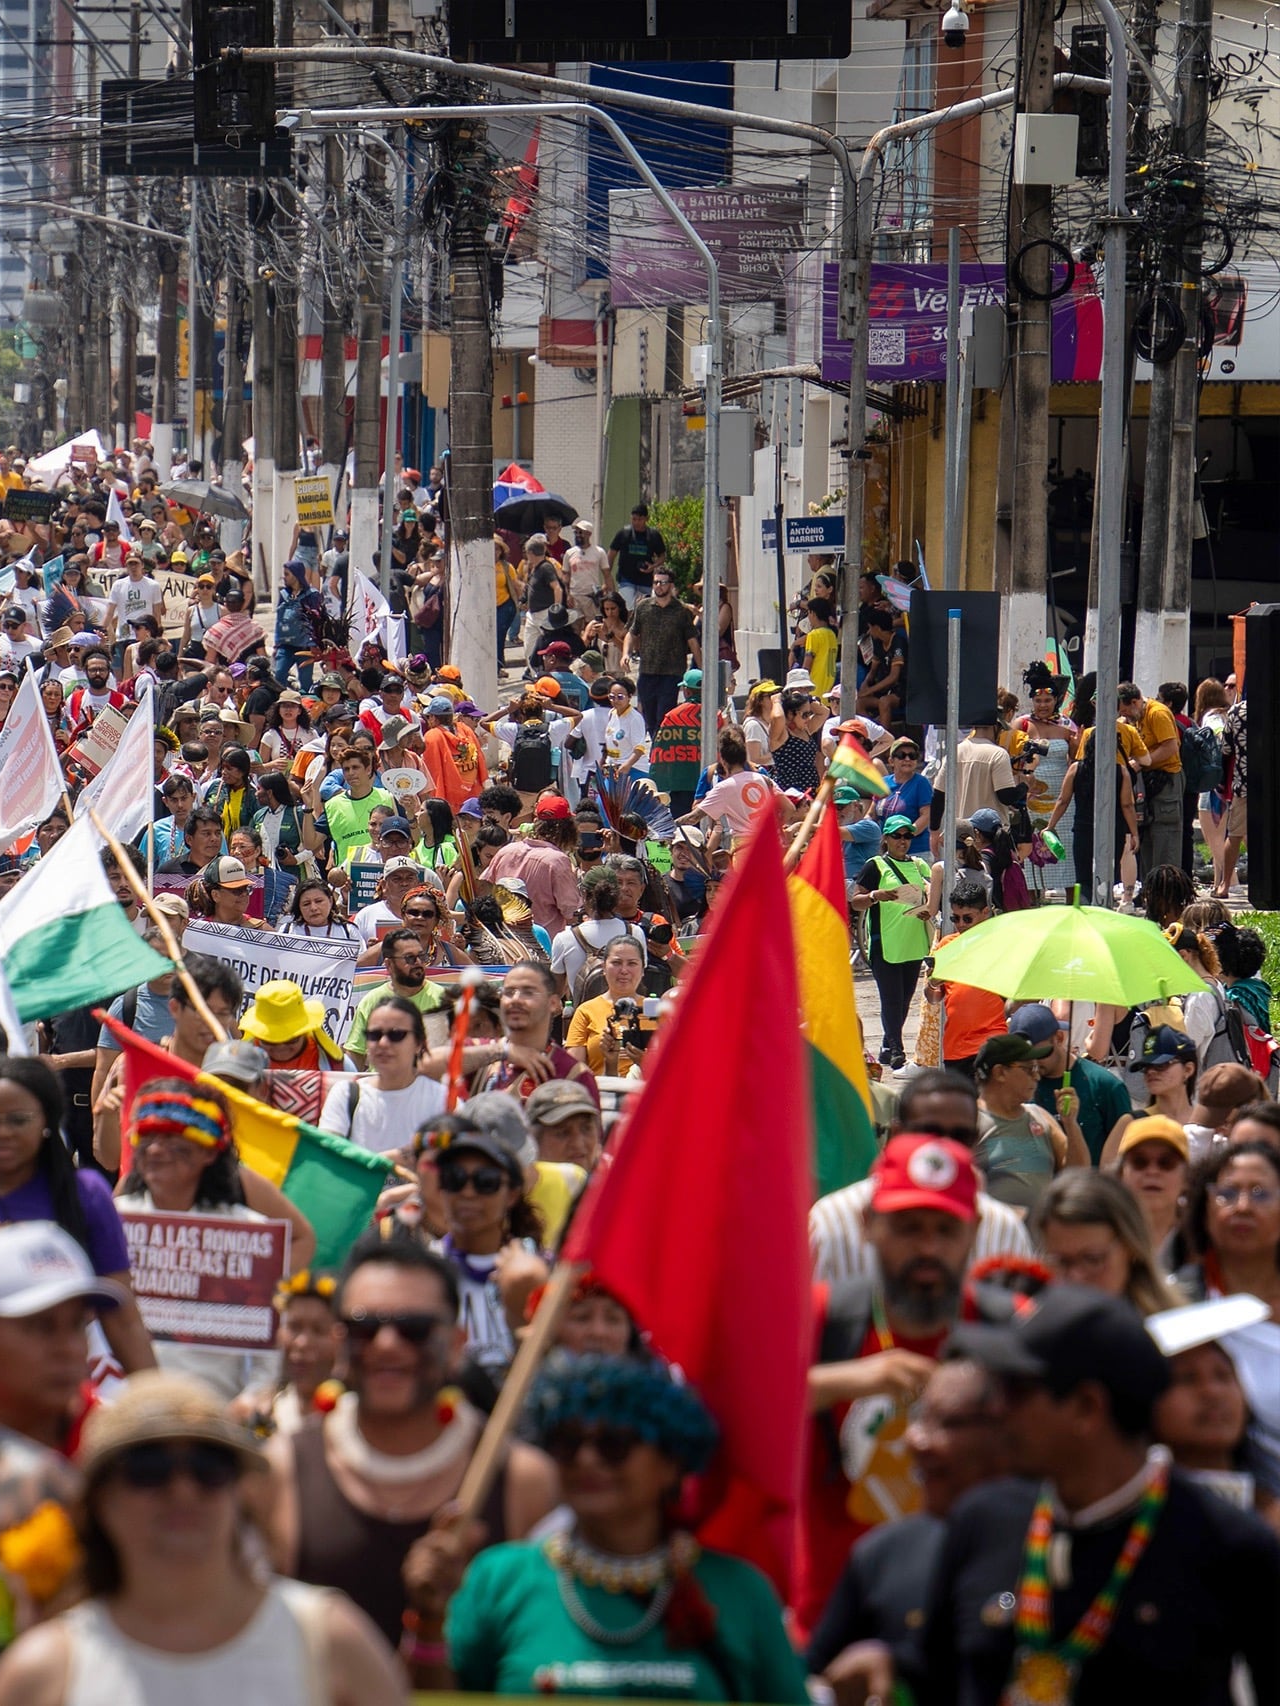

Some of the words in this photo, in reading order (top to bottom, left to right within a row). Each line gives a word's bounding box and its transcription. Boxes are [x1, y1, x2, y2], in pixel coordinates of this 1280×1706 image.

[690, 196, 739, 207] BATISTA
[701, 207, 768, 221] BRILHANTE
[297, 493, 329, 504] AMBIÇÃO
[298, 510, 332, 521] OMISSÃO
[789, 526, 824, 536] ANTÔNIO
[789, 535, 825, 544] BARRETO
[127, 590, 141, 601] EU
[94, 723, 116, 743] DIRETO
[99, 718, 121, 739] ACESSO
[149, 1223, 164, 1249] A
[165, 1225, 200, 1252] LAS
[202, 1227, 273, 1259] RONDAS
[226, 1252, 253, 1280] EN
